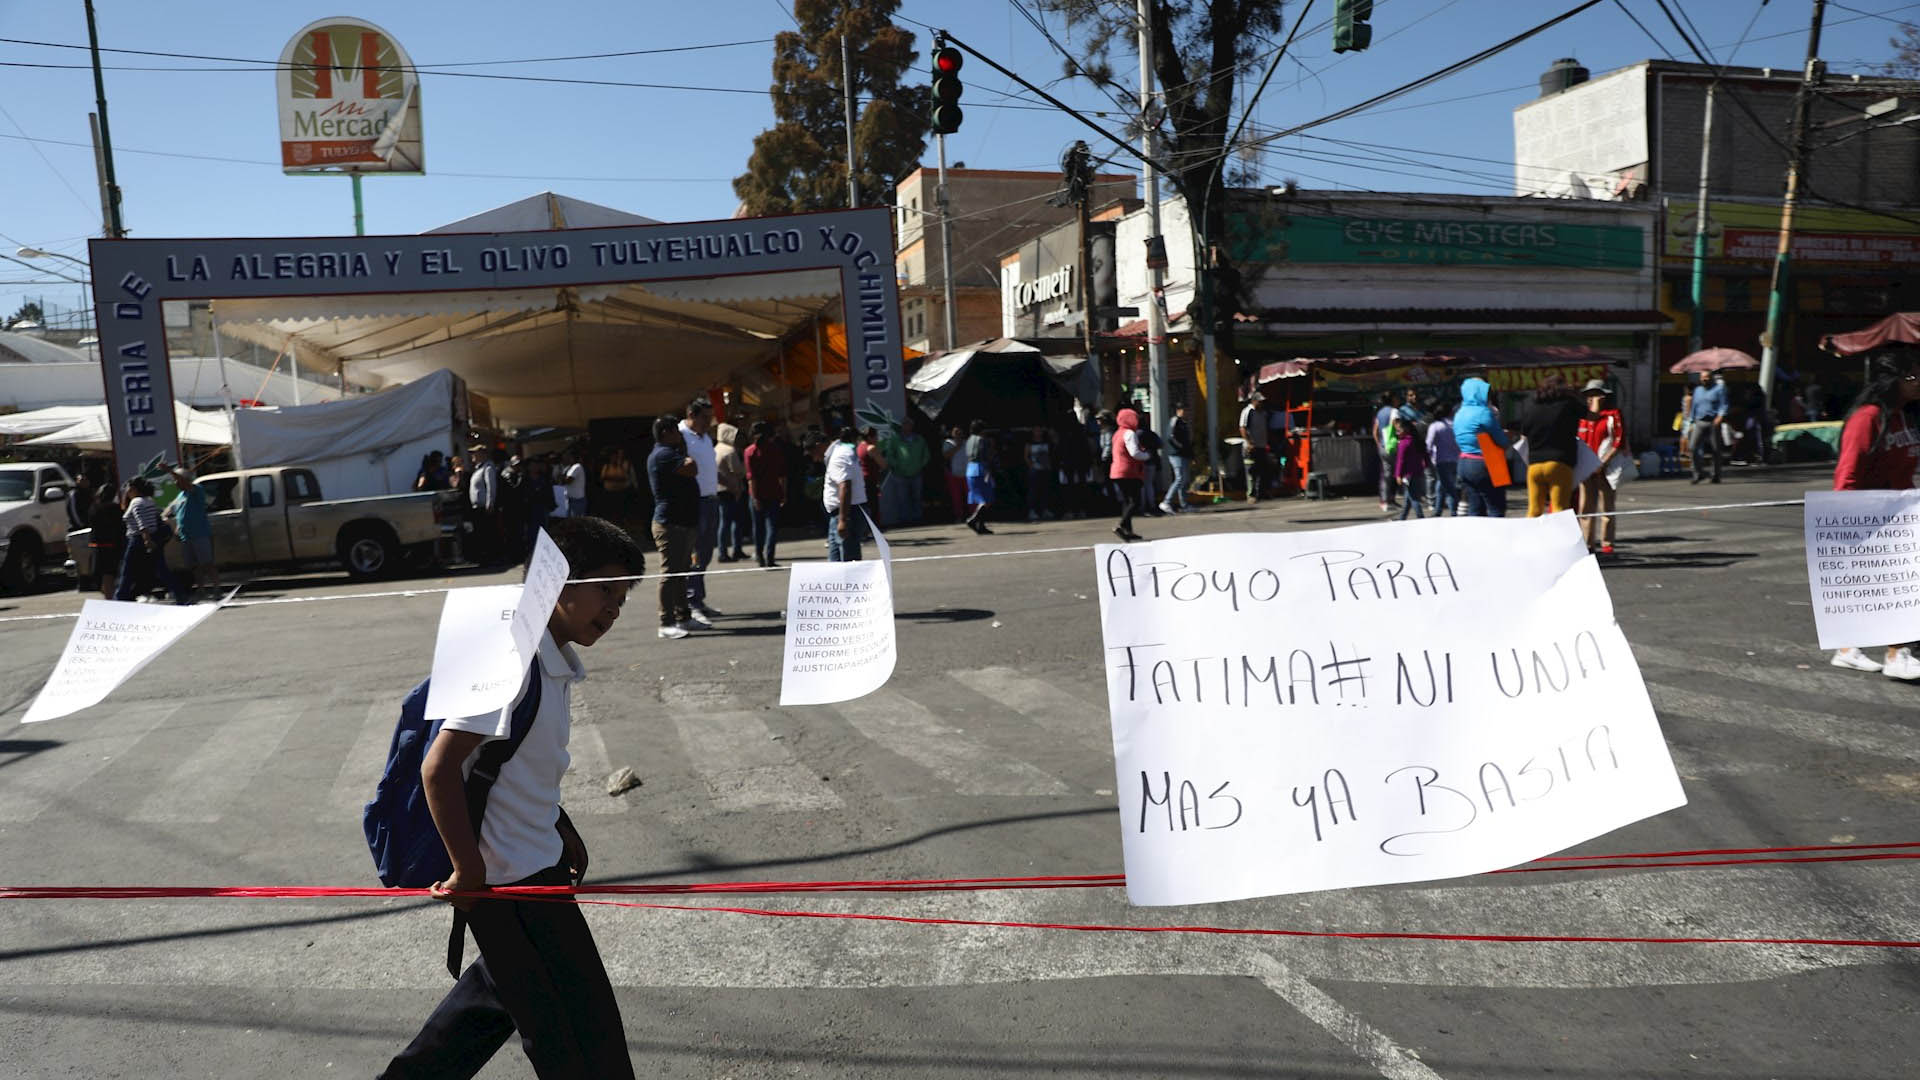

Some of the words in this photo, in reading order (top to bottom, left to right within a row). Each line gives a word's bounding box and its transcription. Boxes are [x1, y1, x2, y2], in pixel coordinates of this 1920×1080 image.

[293, 109, 388, 138] Mercad
[1344, 220, 1404, 243] EYE
[1413, 222, 1557, 247] MASTERS
[479, 243, 571, 273] OLIVO
[589, 228, 804, 268] TULYEHUALCO
[166, 253, 211, 281] LA
[231, 251, 372, 280] ALEGRIA
[384, 250, 402, 276] Y
[420, 249, 463, 275] EL
[112, 270, 153, 321] DE
[817, 225, 892, 393] XOCHIMILCO
[121, 339, 158, 438] FERIA
[1815, 516, 1821, 526] Y
[1825, 516, 1838, 526] LA
[1841, 515, 1880, 526] CULPA
[1882, 514, 1900, 525] NO
[1903, 514, 1920, 524] ER
[1815, 530, 1864, 543] (FATIMA,
[1866, 530, 1872, 540] 7
[1816, 546, 1828, 556] NI
[1830, 545, 1846, 556] EN
[1849, 543, 1891, 555] DÓNDE
[1894, 542, 1920, 553] EST
[1818, 561, 1849, 573] (ESC.
[1851, 557, 1911, 570] PRIMARIA
[799, 582, 806, 591] Y
[808, 582, 823, 591] LA
[825, 582, 860, 592] CULPA
[1105, 547, 1281, 613] APOYO
[1287, 549, 1460, 602] PARA
[1820, 576, 1832, 585] NI
[1834, 573, 1871, 585] CÓMO
[845, 595, 851, 604] 7
[1822, 587, 1889, 601] (UNIFORME
[1893, 584, 1920, 595] ESC
[796, 609, 808, 618] NI
[810, 609, 825, 618] EN
[1824, 598, 1920, 615] #JUSTICIAPARA
[794, 637, 806, 646] NI
[807, 635, 840, 645] CÓMO
[796, 623, 823, 633] (ESC.
[793, 649, 850, 661] (UNIFORME
[1490, 629, 1607, 699] UNA
[1138, 769, 1244, 834] MAS
[1292, 767, 1358, 843] YA
